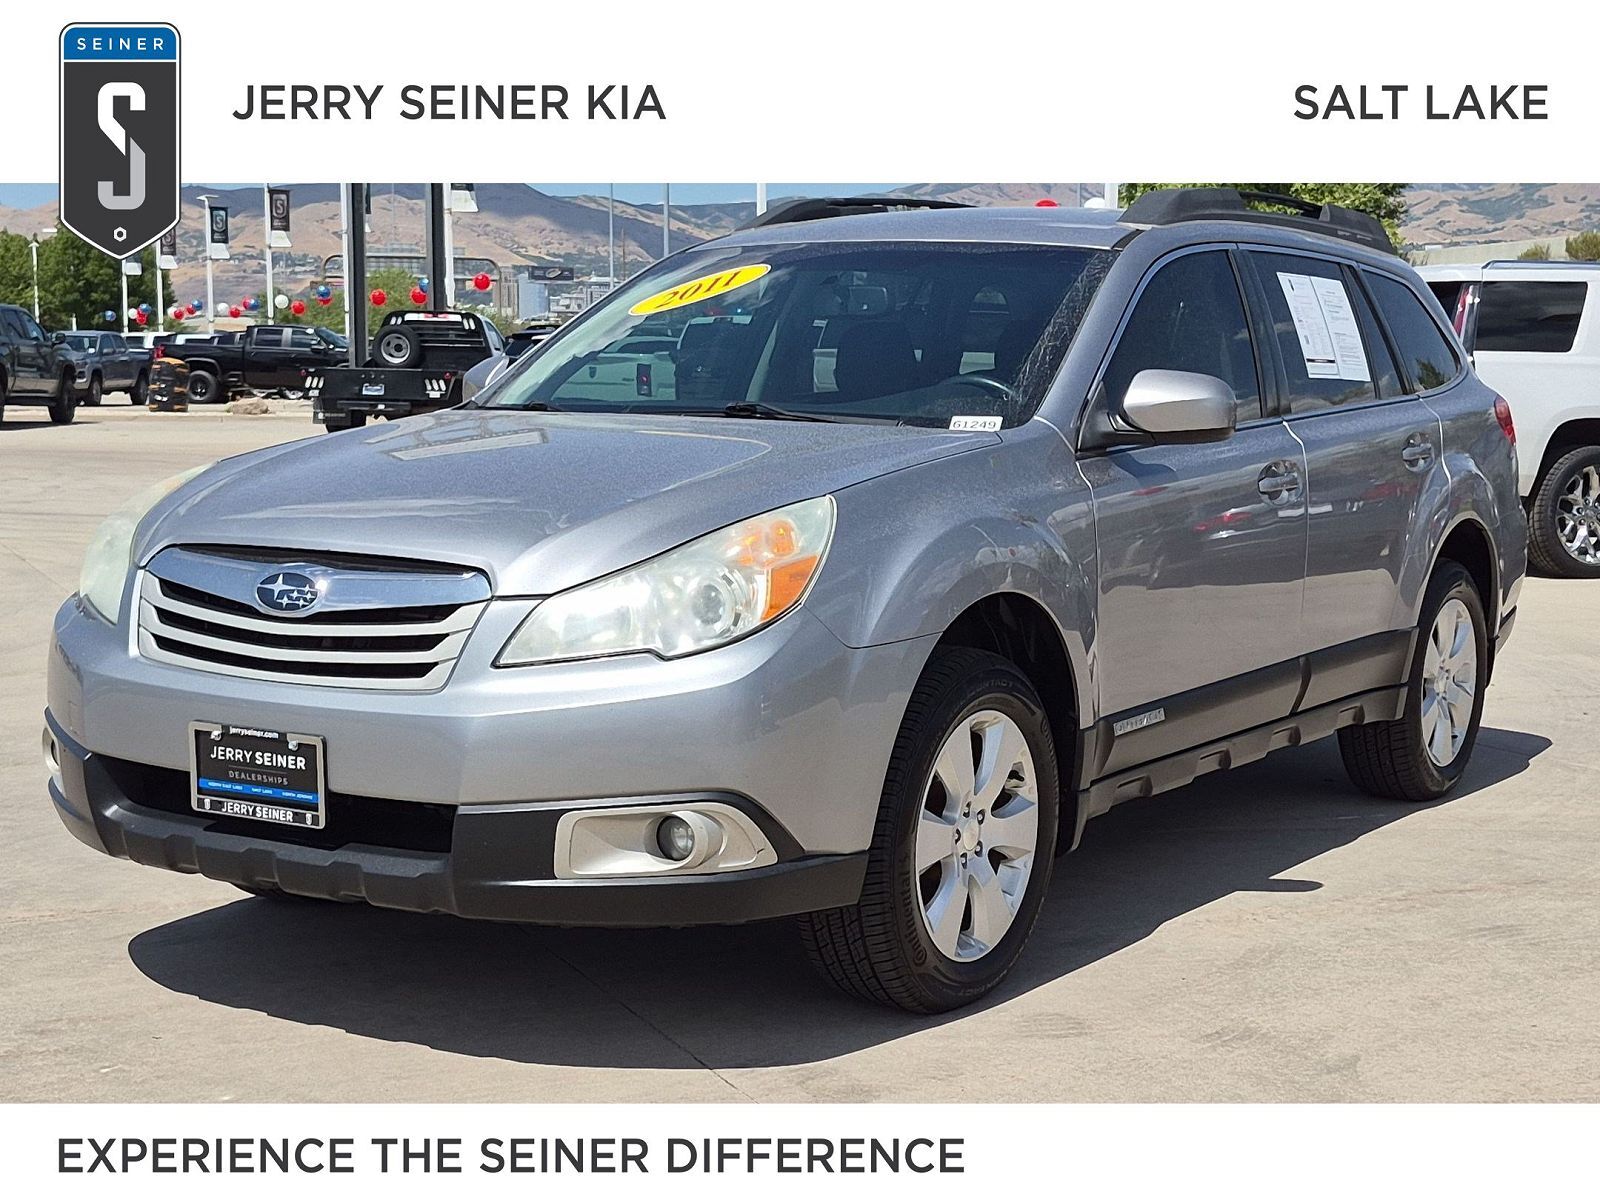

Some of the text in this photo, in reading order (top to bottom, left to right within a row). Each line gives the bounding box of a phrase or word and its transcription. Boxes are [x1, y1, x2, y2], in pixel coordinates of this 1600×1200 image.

[655, 270, 742, 309] 2011
[210, 745, 306, 770] JERRY SEINER
[228, 770, 289, 786] DEALERSHIPS
[221, 801, 254, 816] JERRY
[255, 806, 294, 822] SEINER
